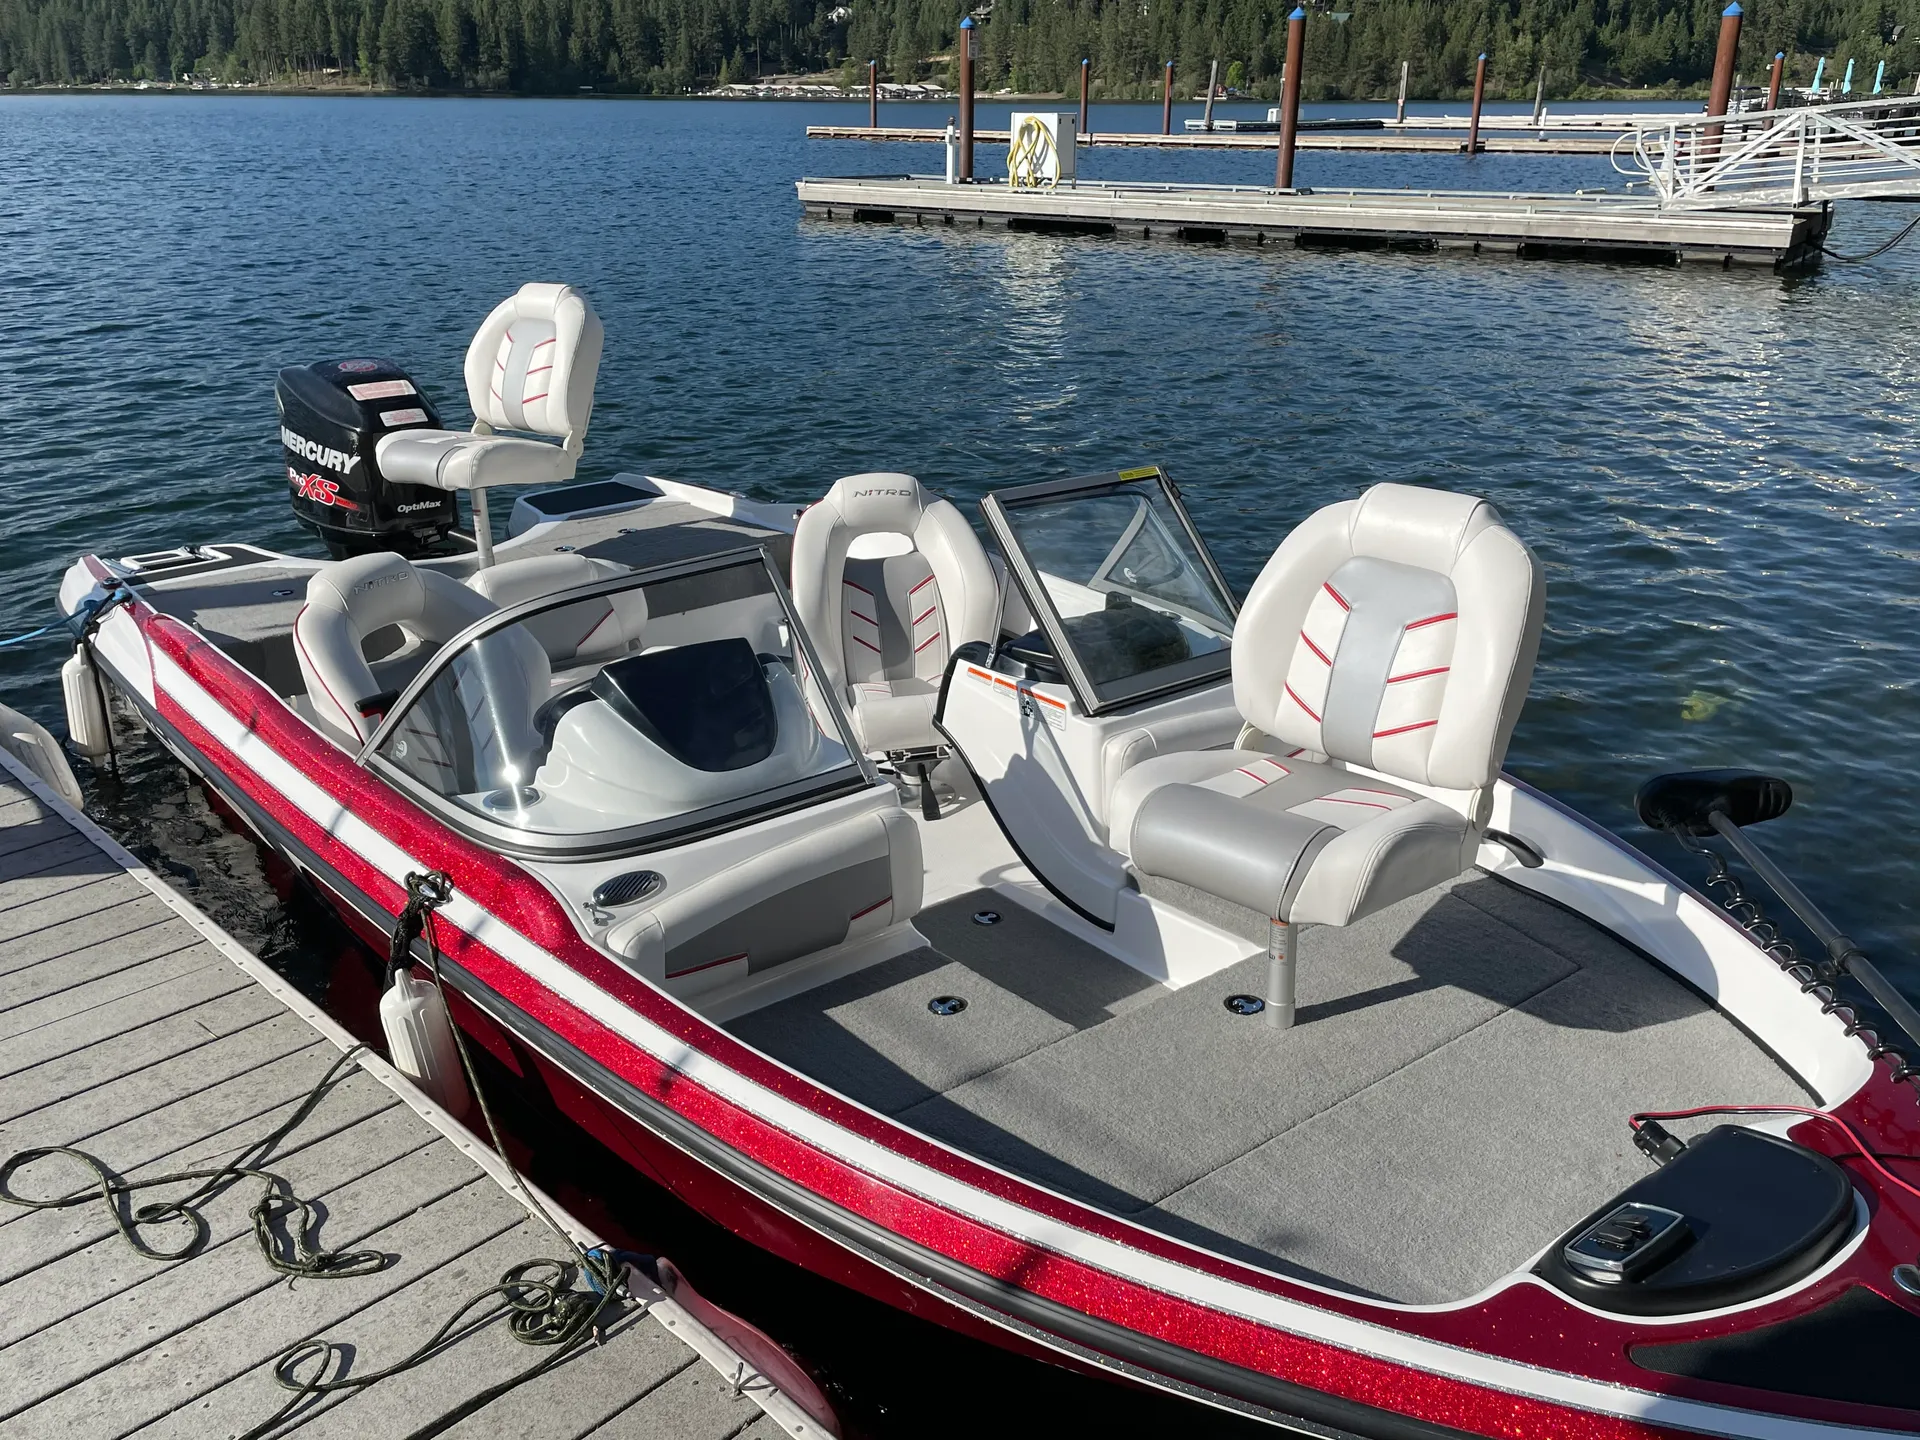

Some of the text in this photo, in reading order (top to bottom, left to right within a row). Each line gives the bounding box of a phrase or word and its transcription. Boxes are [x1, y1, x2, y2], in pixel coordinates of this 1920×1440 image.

[281, 425, 361, 475] MERCURY
[853, 488, 912, 498] NITRO
[397, 500, 442, 514] OptiMax
[353, 571, 409, 595] NITRO
